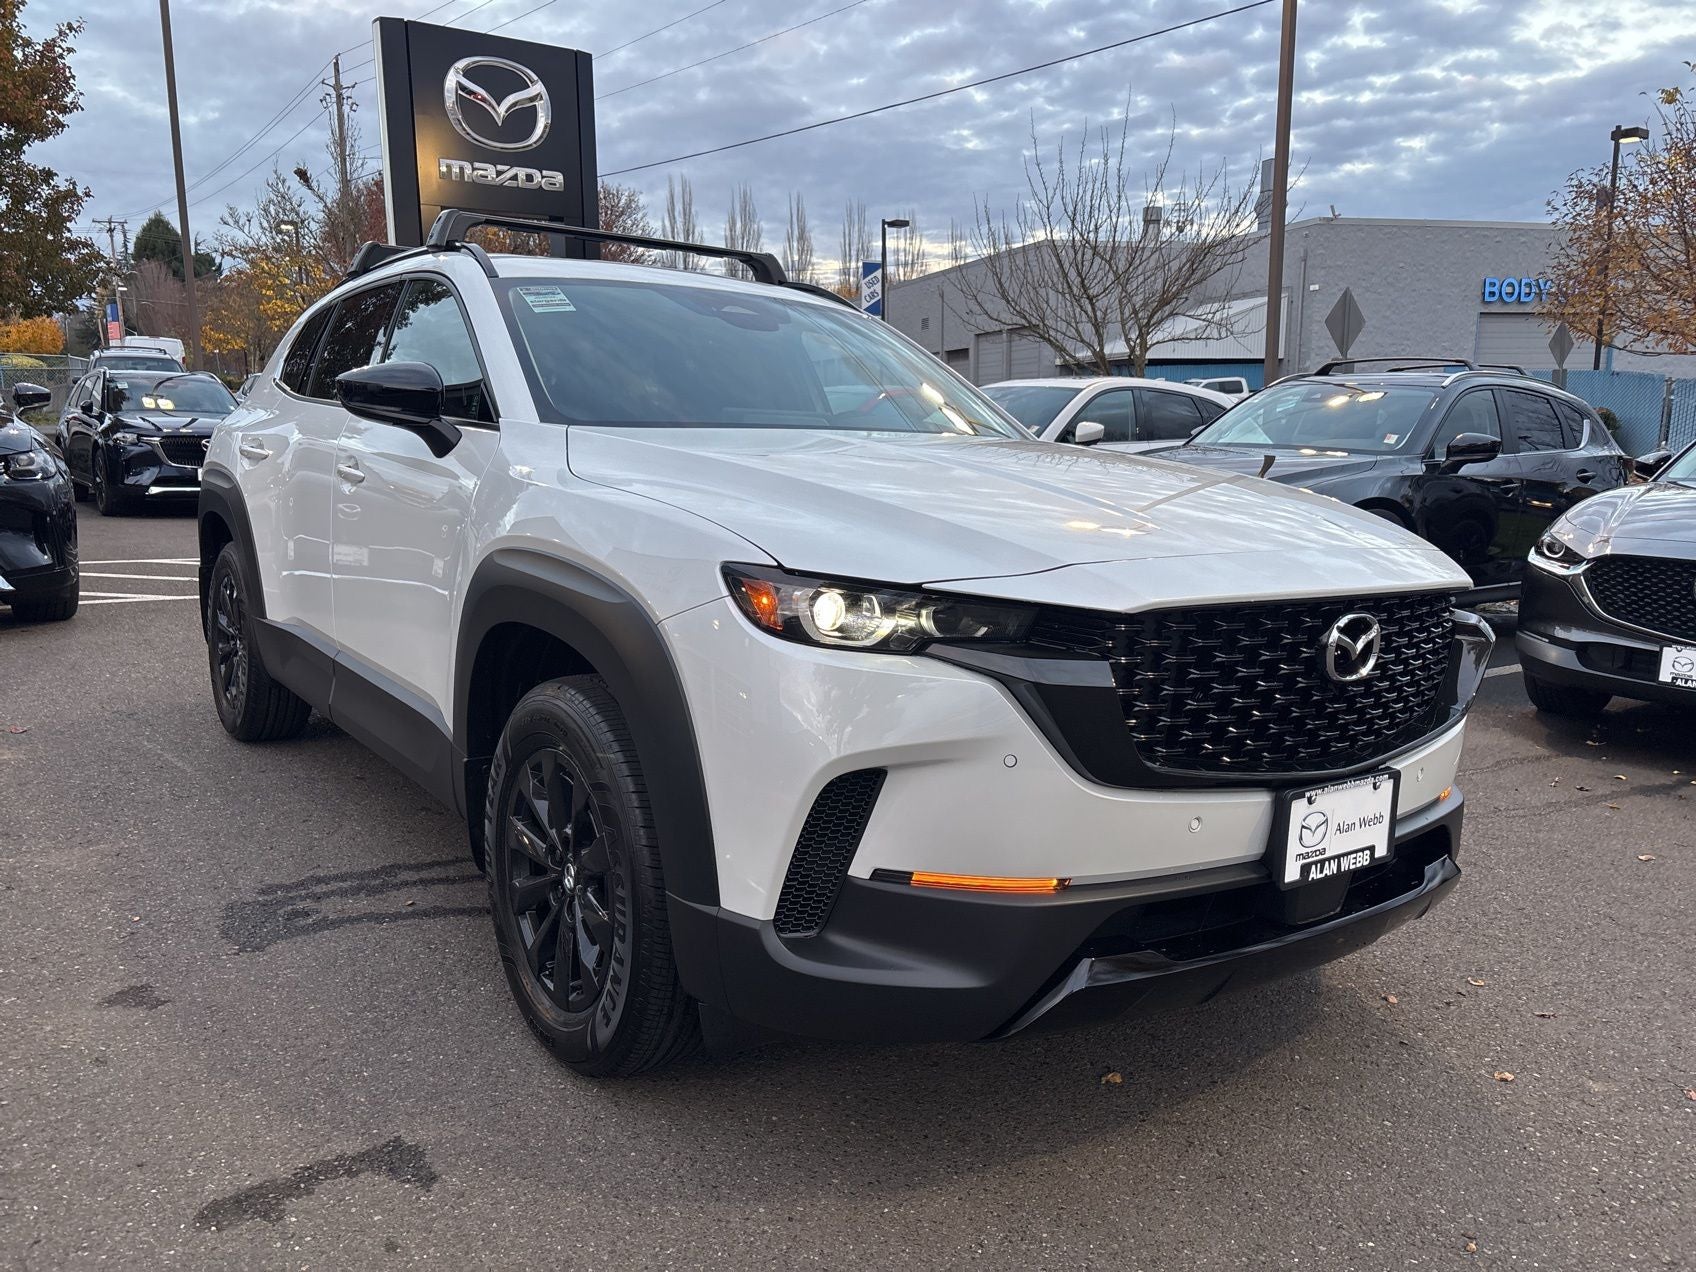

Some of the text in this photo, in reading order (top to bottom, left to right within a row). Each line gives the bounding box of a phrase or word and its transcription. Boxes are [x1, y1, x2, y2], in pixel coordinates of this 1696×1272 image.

[438, 158, 564, 192] mazda
[864, 275, 880, 289] USED
[1483, 277, 1552, 302] BODY
[864, 289, 880, 303] CARS
[1334, 811, 1384, 836] Alan Webb
[1295, 847, 1326, 862] mazda
[1308, 850, 1371, 881] ALAN WEBB
[601, 826, 627, 1029] ASSURANCE
